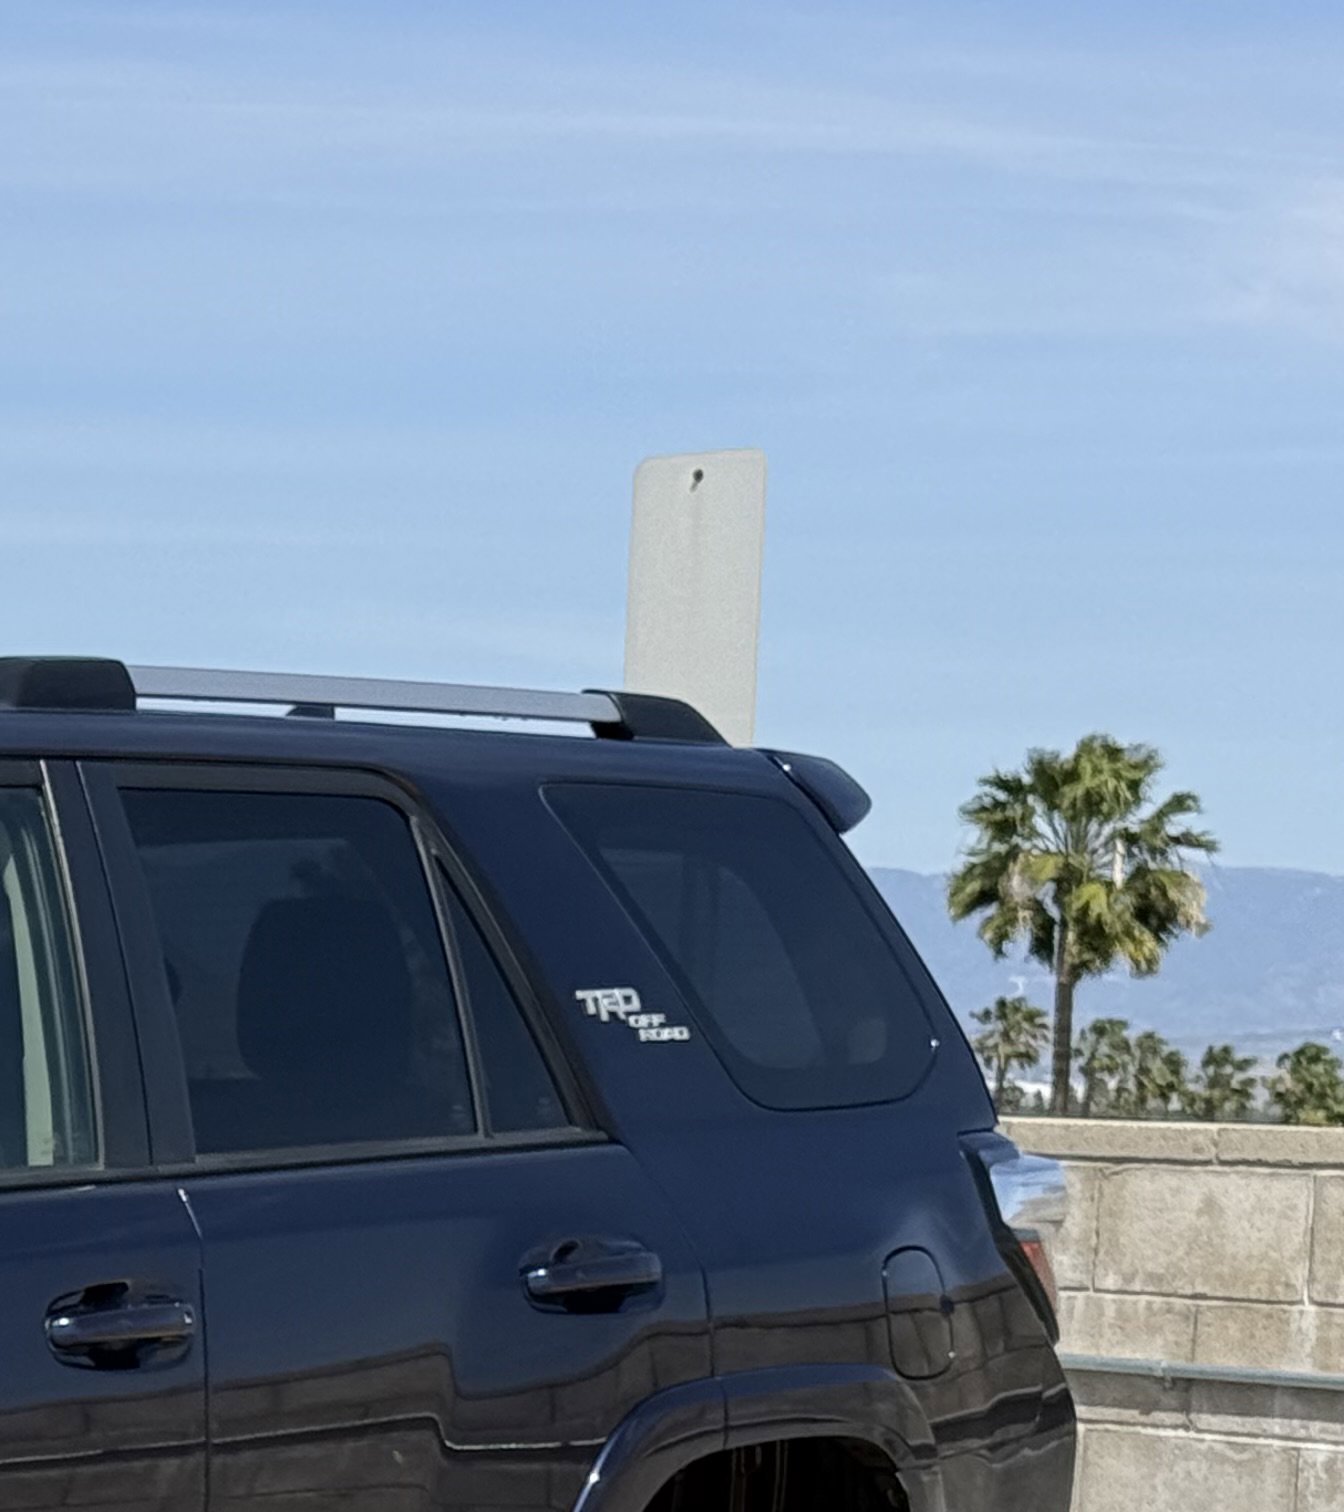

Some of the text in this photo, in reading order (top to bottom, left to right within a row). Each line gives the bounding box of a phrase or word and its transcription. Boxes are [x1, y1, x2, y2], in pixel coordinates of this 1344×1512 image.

[575, 987, 642, 1022] TRD
[628, 1012, 666, 1028] OFF
[638, 1025, 691, 1042] ROAD
